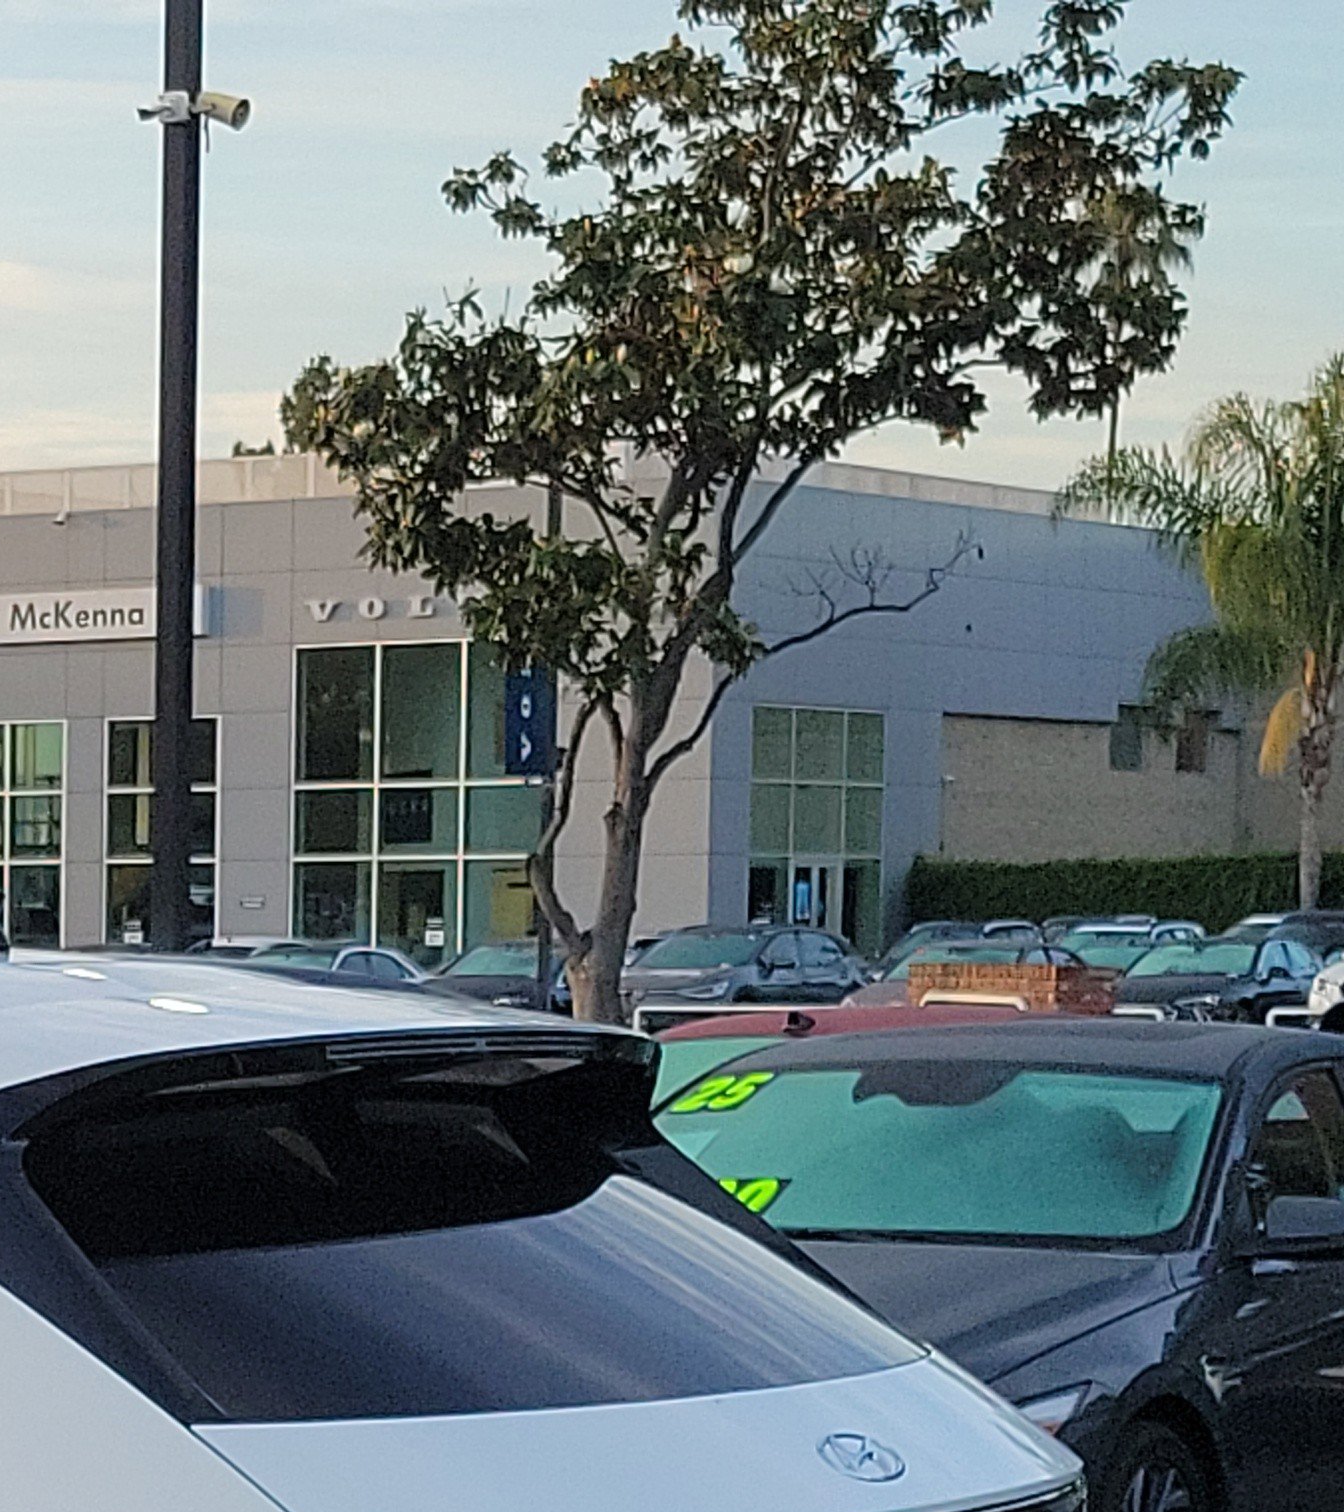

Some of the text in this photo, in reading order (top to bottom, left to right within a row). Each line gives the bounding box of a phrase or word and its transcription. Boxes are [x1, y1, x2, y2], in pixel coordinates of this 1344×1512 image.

[9, 600, 145, 631] McKenna
[304, 596, 436, 623] VOL
[669, 1071, 775, 1114] 25
